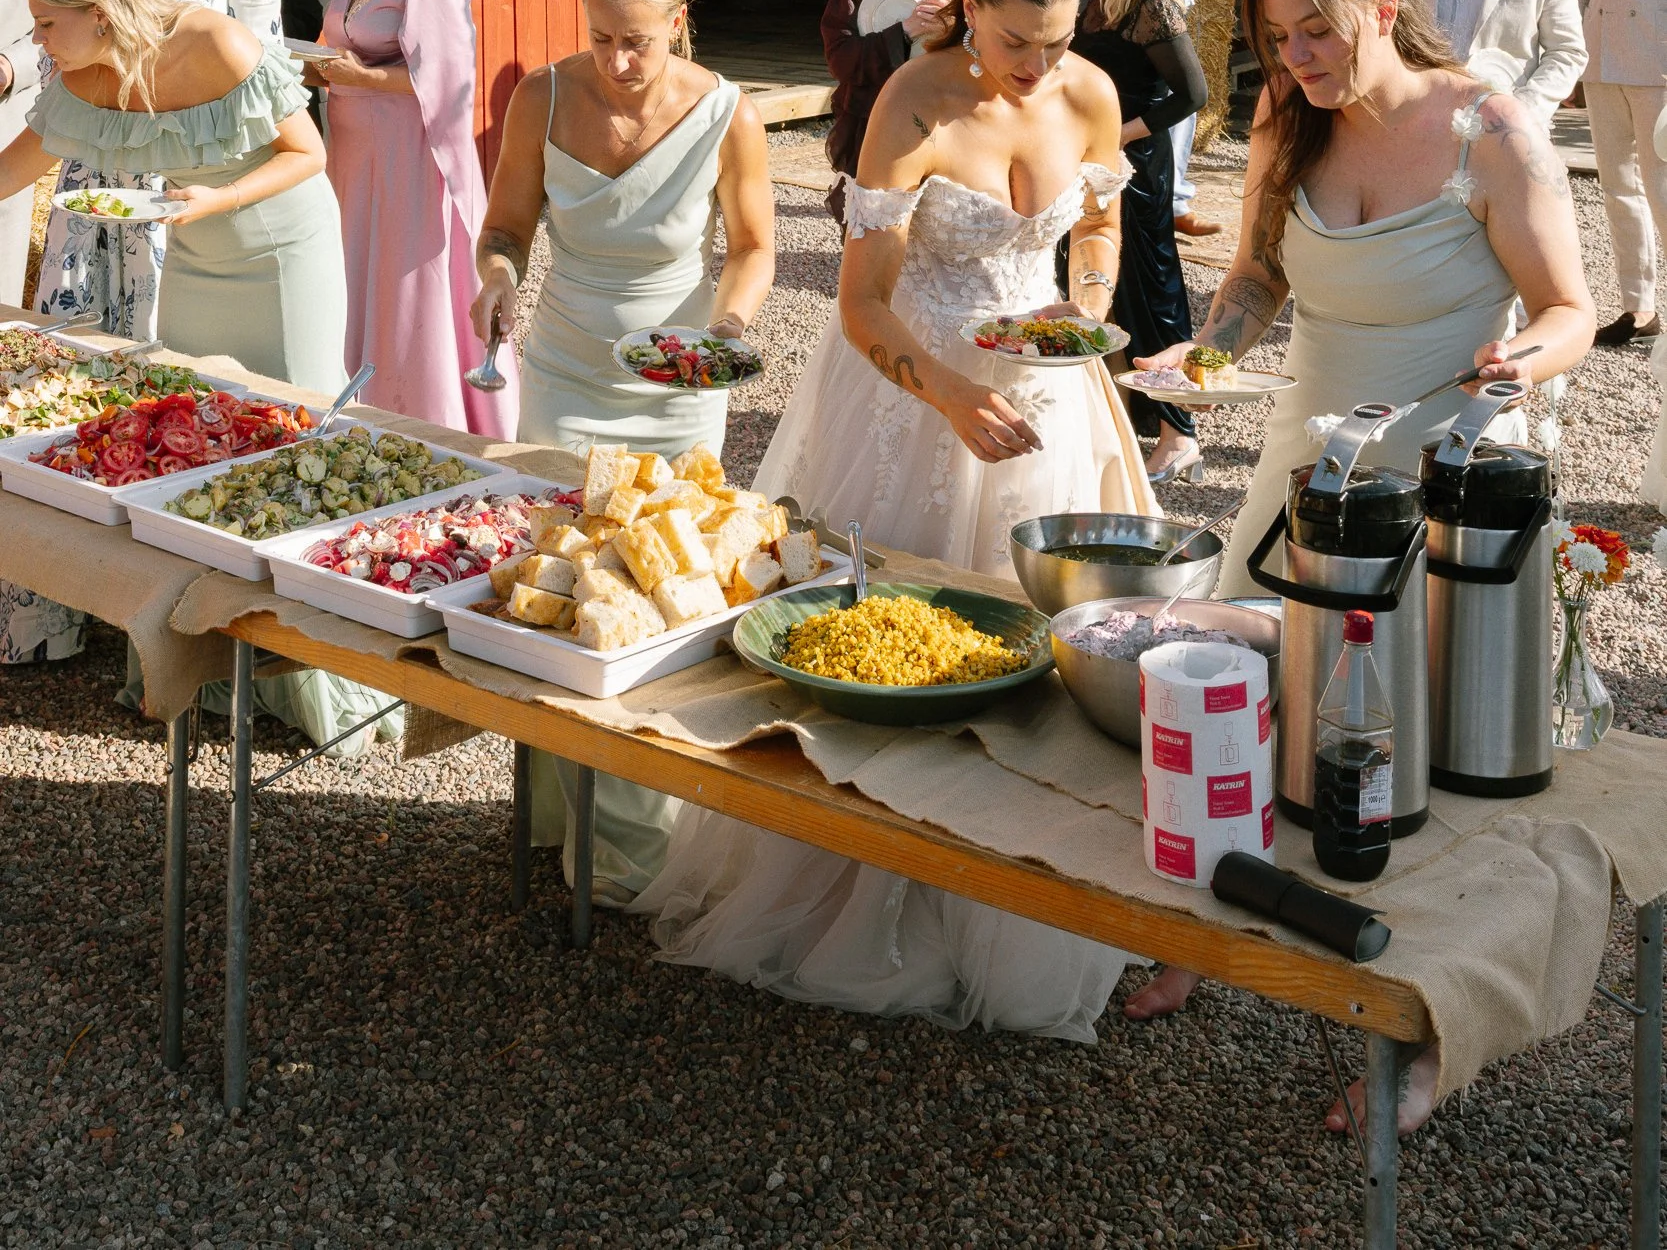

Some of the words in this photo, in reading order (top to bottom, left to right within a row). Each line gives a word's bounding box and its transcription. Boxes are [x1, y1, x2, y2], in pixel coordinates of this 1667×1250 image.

[1155, 731, 1184, 746] KATRIN
[1213, 780, 1246, 791] KATRIN
[1158, 836, 1187, 851] KATRIN
